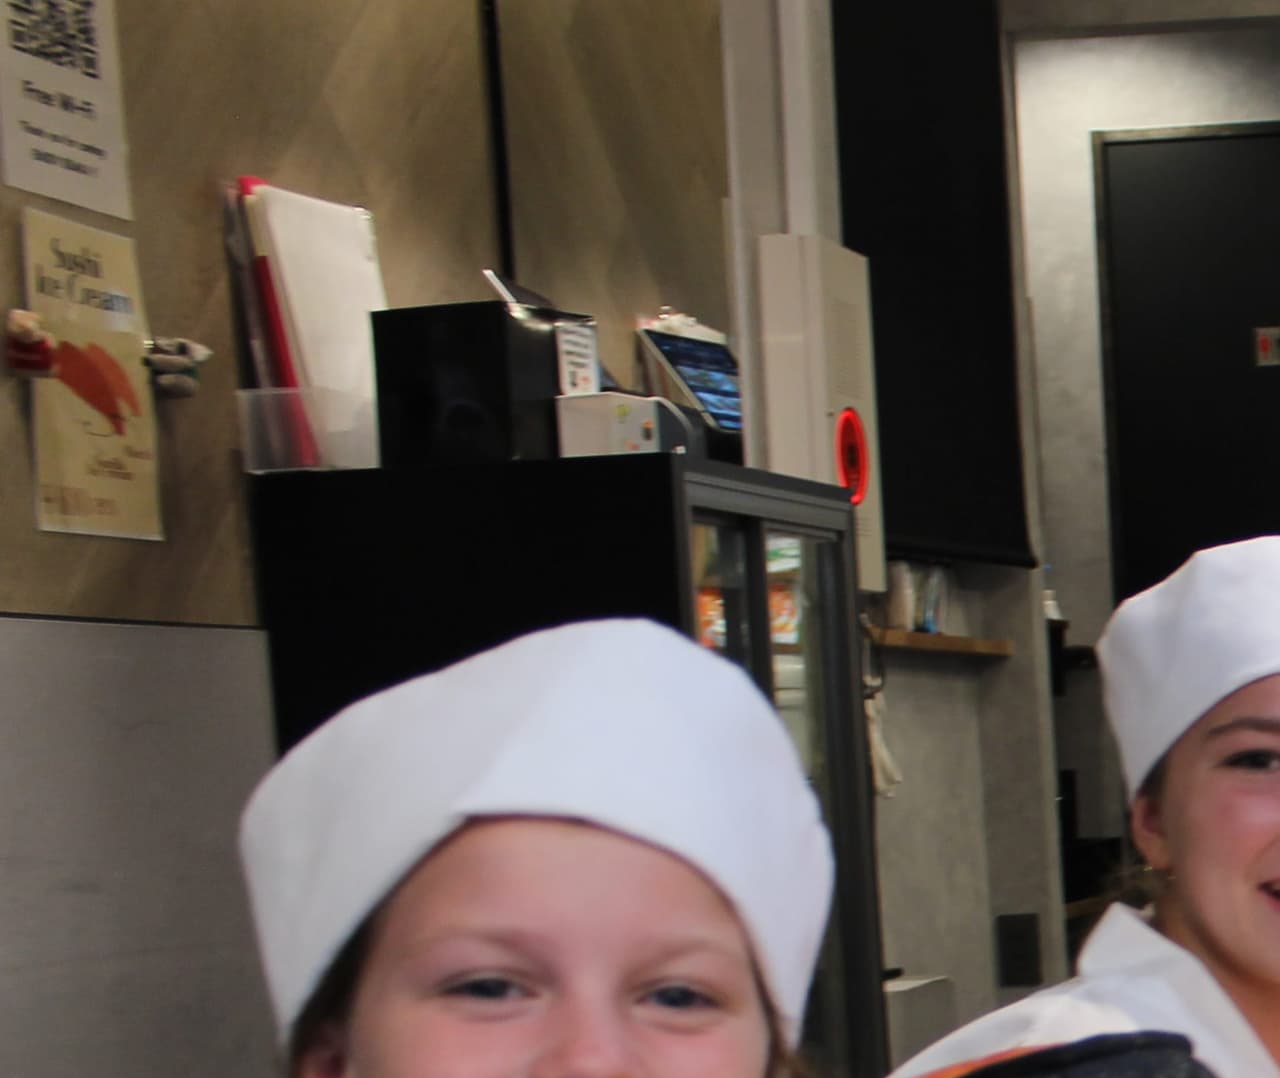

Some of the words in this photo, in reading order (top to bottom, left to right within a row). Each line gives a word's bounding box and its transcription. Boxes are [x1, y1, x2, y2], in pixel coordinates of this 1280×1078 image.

[22, 80, 56, 107] Free
[49, 237, 104, 279] Sushi
[35, 263, 65, 299] Ice
[66, 273, 134, 314] Cream
